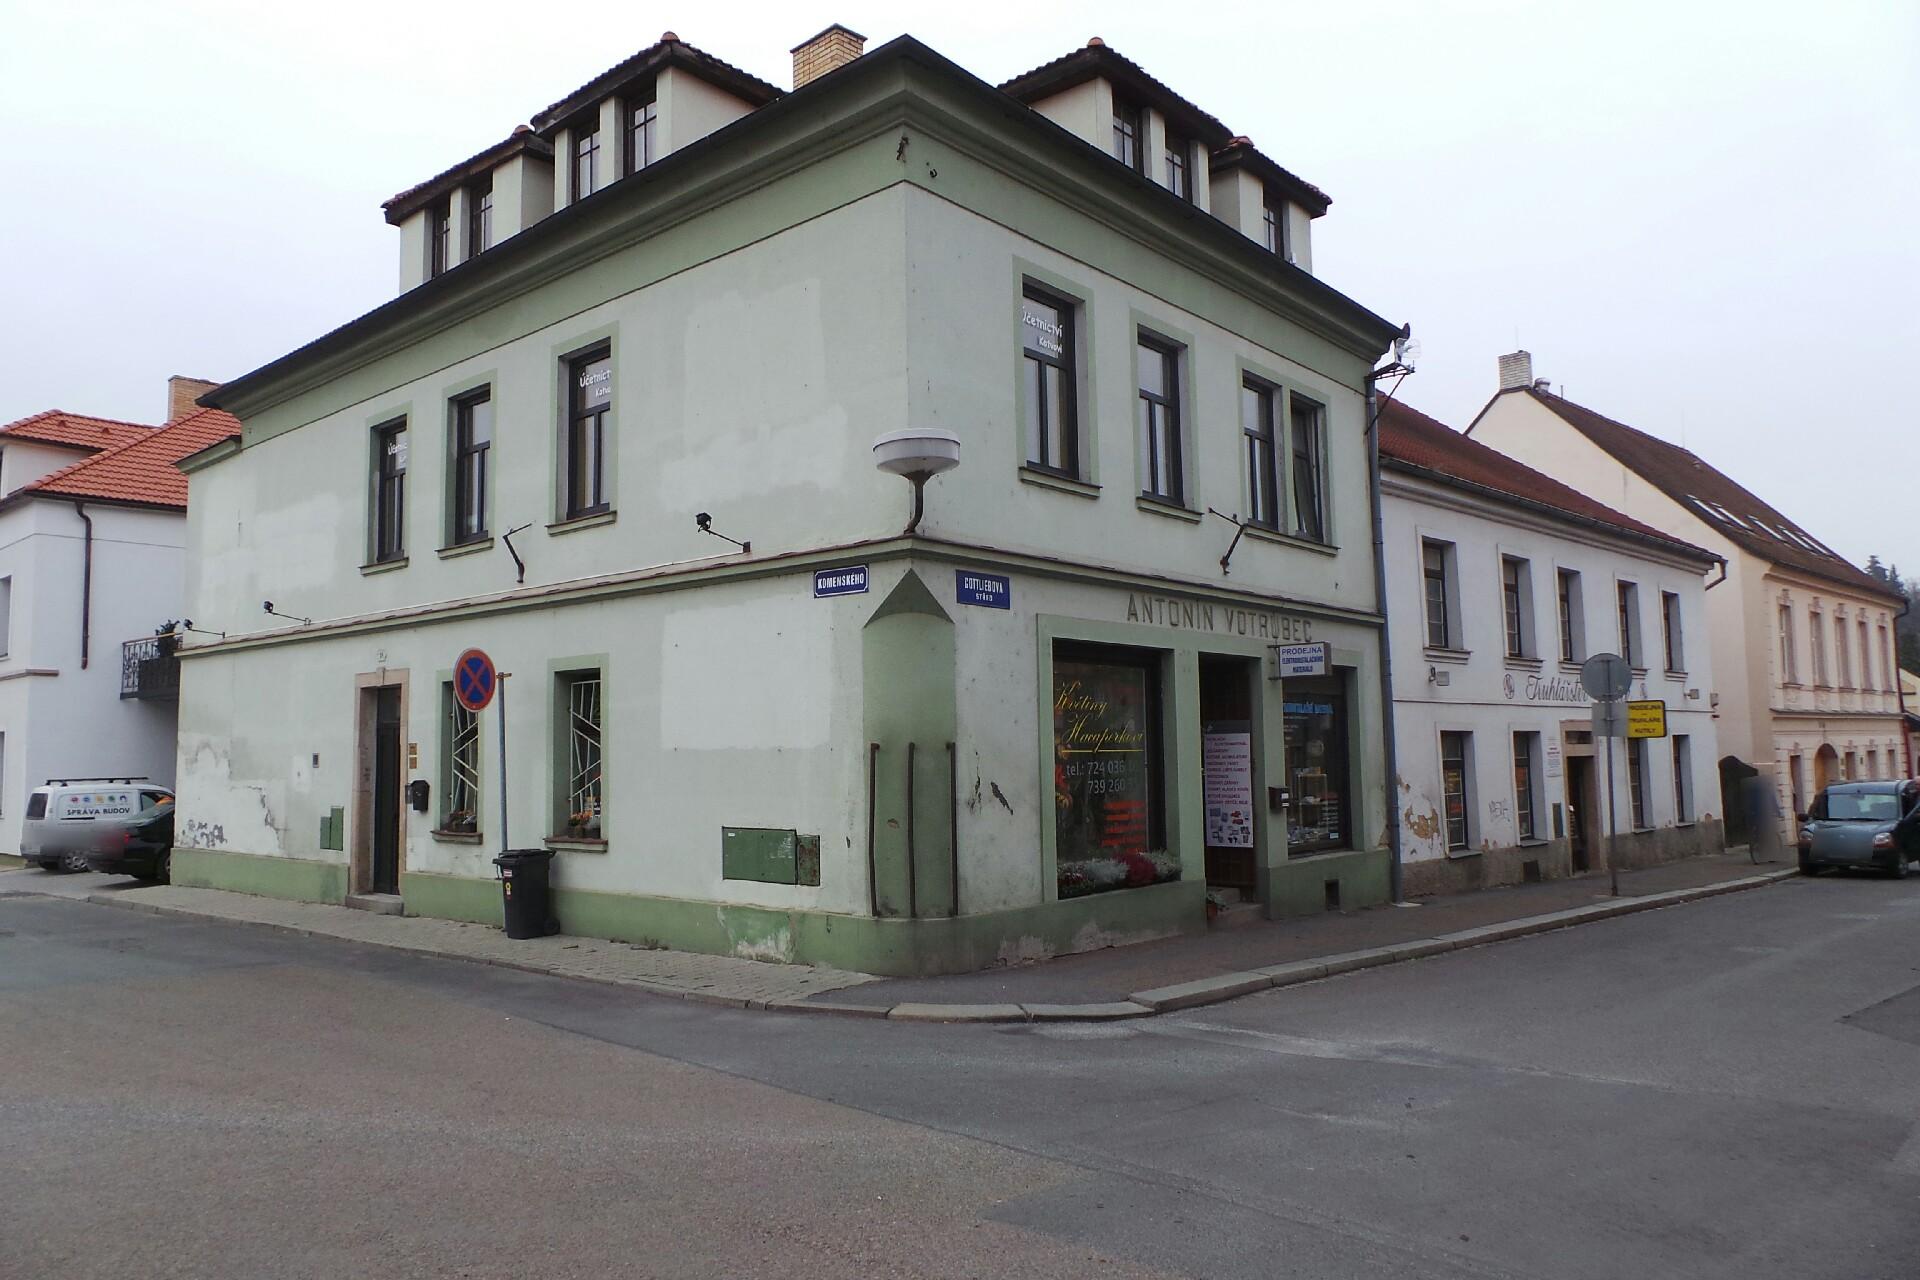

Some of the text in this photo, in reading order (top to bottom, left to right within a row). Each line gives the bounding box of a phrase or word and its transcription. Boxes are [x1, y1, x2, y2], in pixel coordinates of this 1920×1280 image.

[817, 573, 865, 589] KOMENSKÉHO
[964, 577, 1004, 594] GOTTLIEBOVA
[1126, 593, 1214, 631] ANTONÍN
[1281, 646, 1322, 655] PRODEJNA
[1088, 761, 1105, 775] 724
[1088, 779, 1106, 794] 739
[67, 807, 130, 816] SPRÁVA BUDOV
